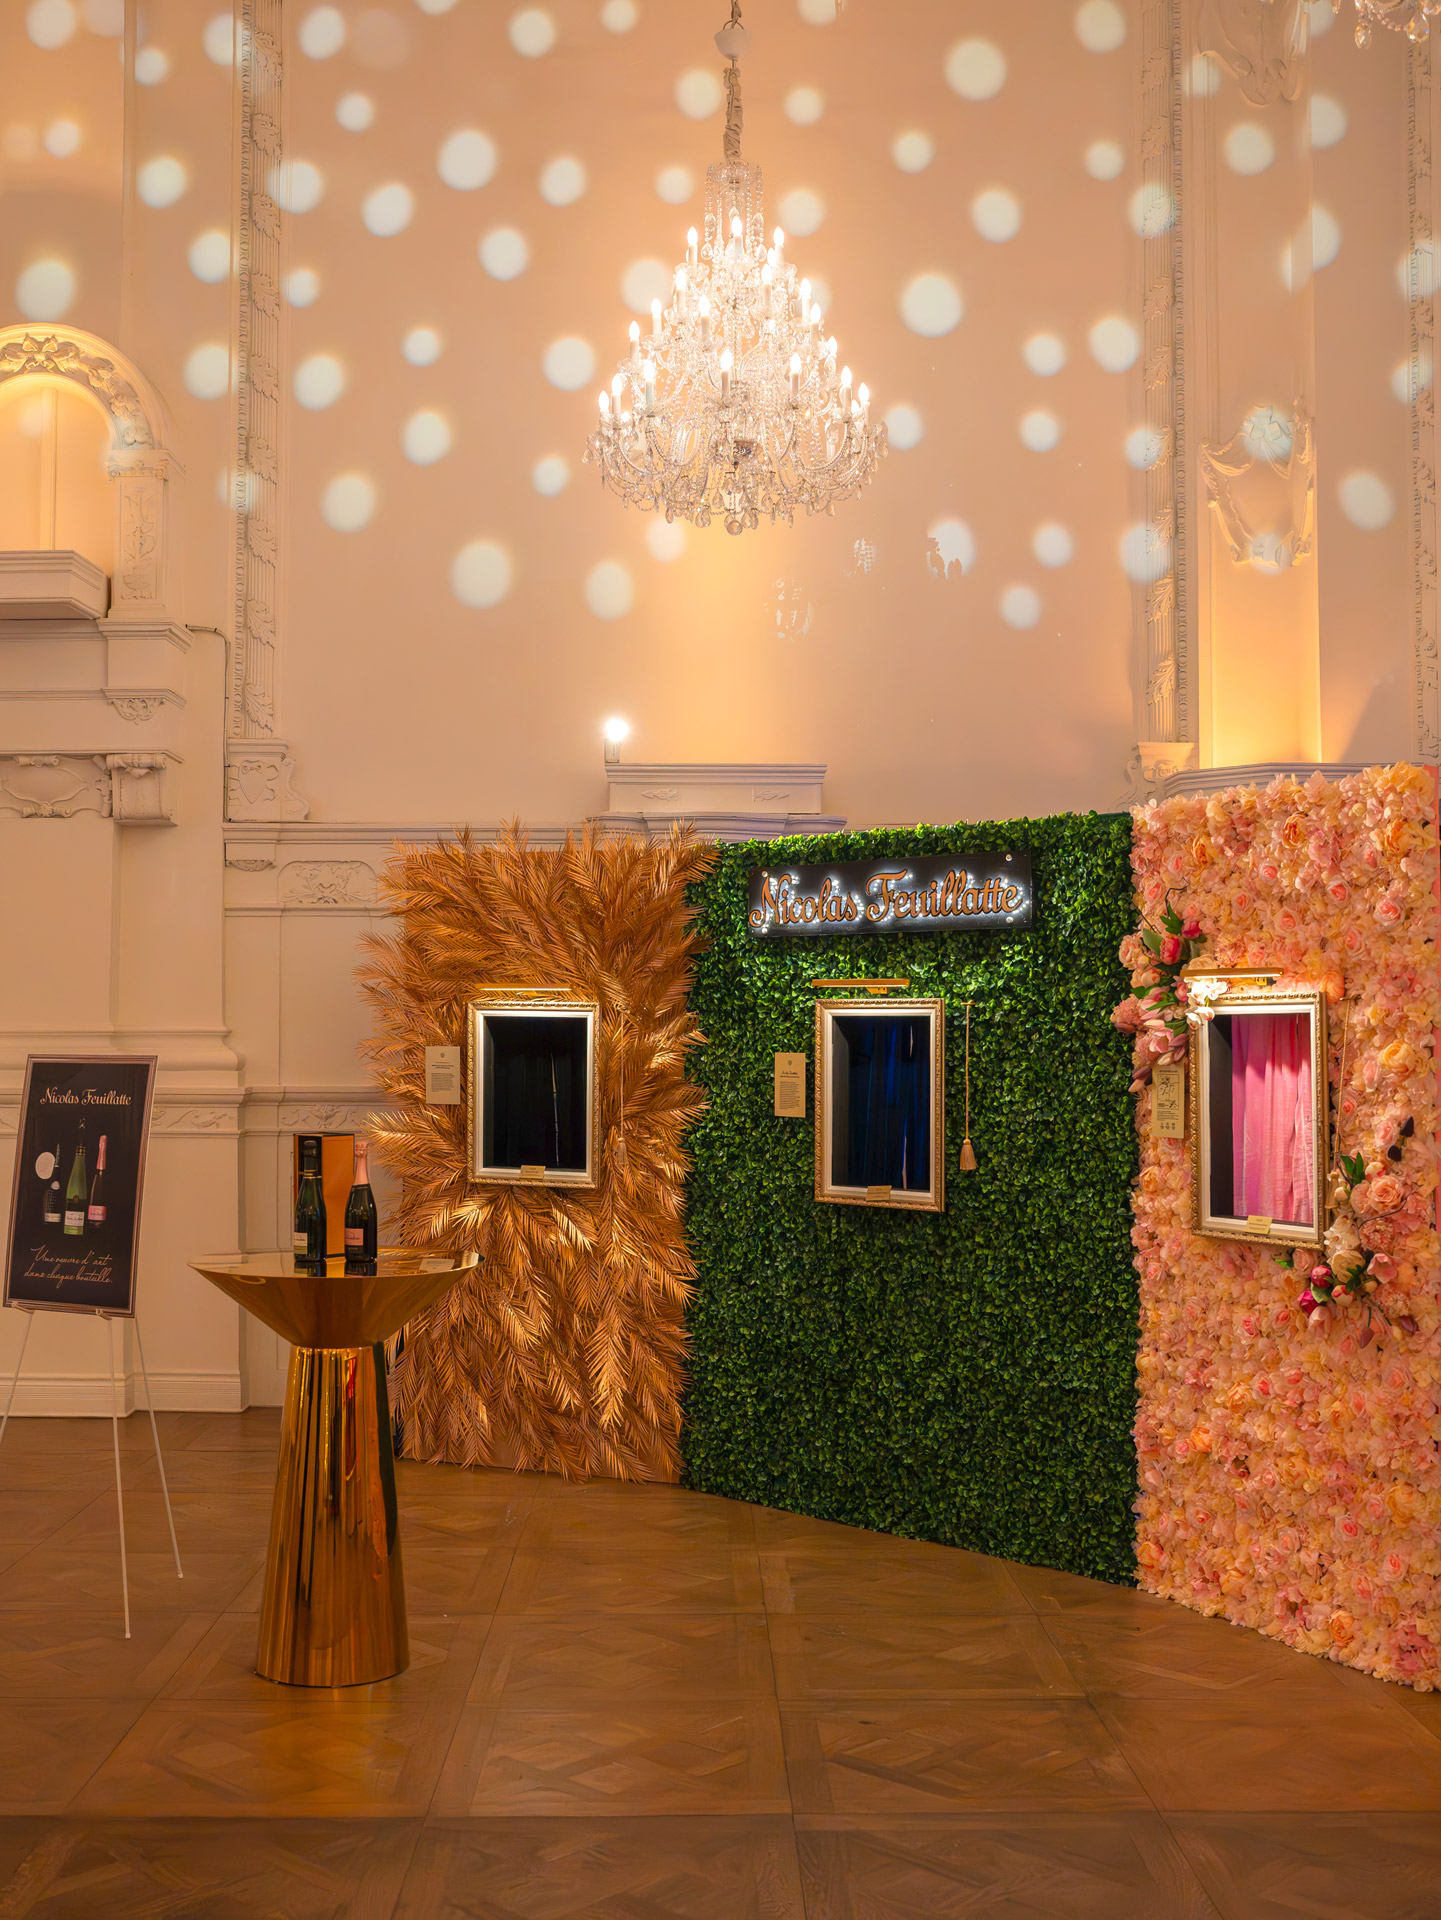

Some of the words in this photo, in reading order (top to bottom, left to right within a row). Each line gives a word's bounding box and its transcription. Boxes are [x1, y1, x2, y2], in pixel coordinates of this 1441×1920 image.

[749, 873, 858, 928] Nicolas
[866, 869, 1023, 922] Feuillatte
[40, 1086, 79, 1105] Nicolas
[81, 1088, 132, 1106] Feuillatte
[30, 1244, 54, 1262] Une
